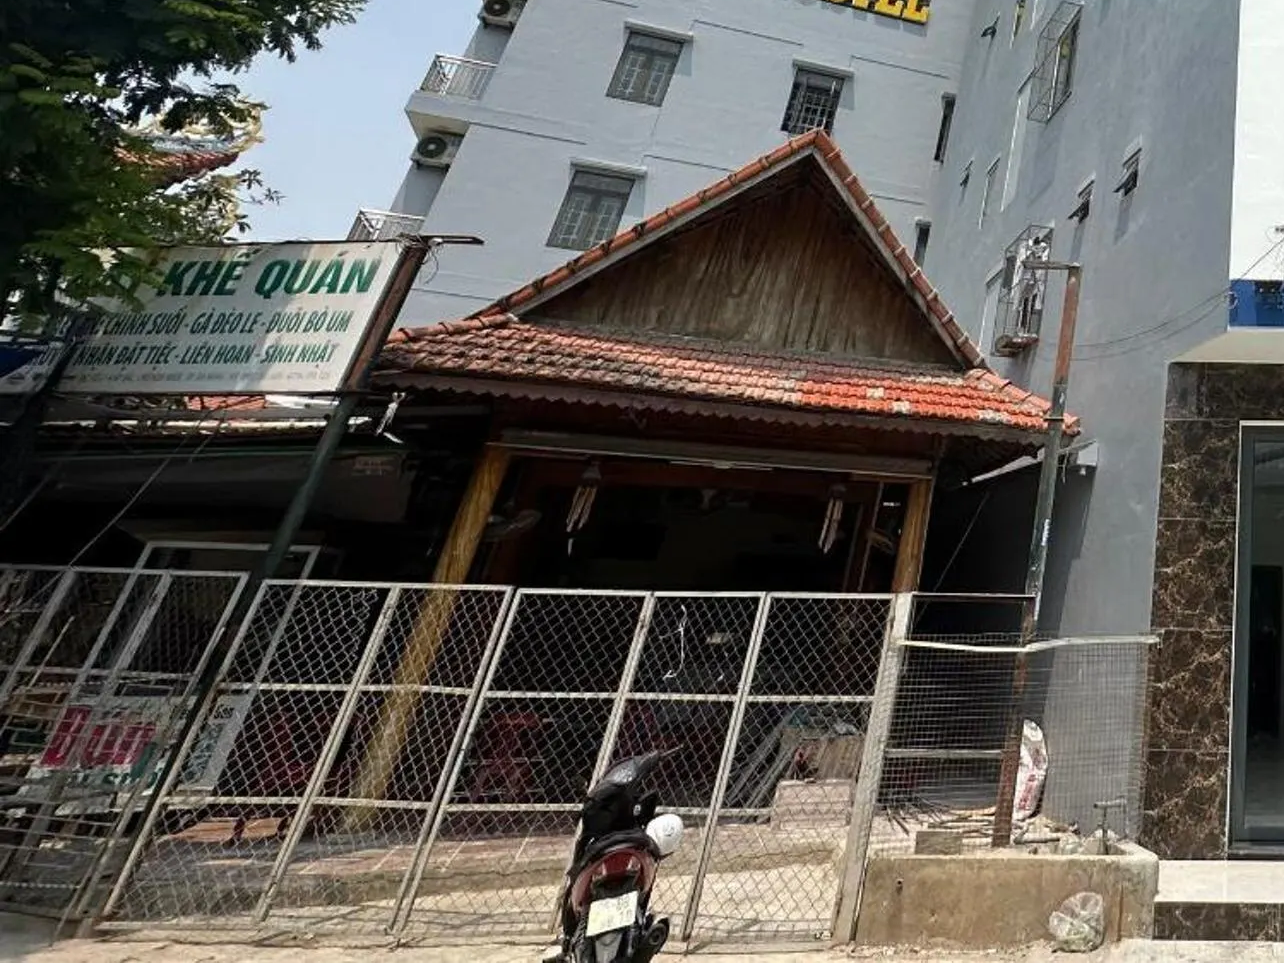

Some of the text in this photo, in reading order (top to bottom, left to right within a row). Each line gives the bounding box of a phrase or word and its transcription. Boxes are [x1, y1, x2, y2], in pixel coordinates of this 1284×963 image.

[255, 250, 382, 299] QUÁN
[145, 304, 188, 335] SUỐI
[189, 307, 216, 334] GÀ
[239, 312, 263, 334] LE
[303, 305, 329, 333] BÒ
[179, 340, 216, 365] LIÊN
[212, 343, 257, 365] HOAN
[260, 343, 299, 365] SINH
[295, 340, 339, 369] NHẬT
